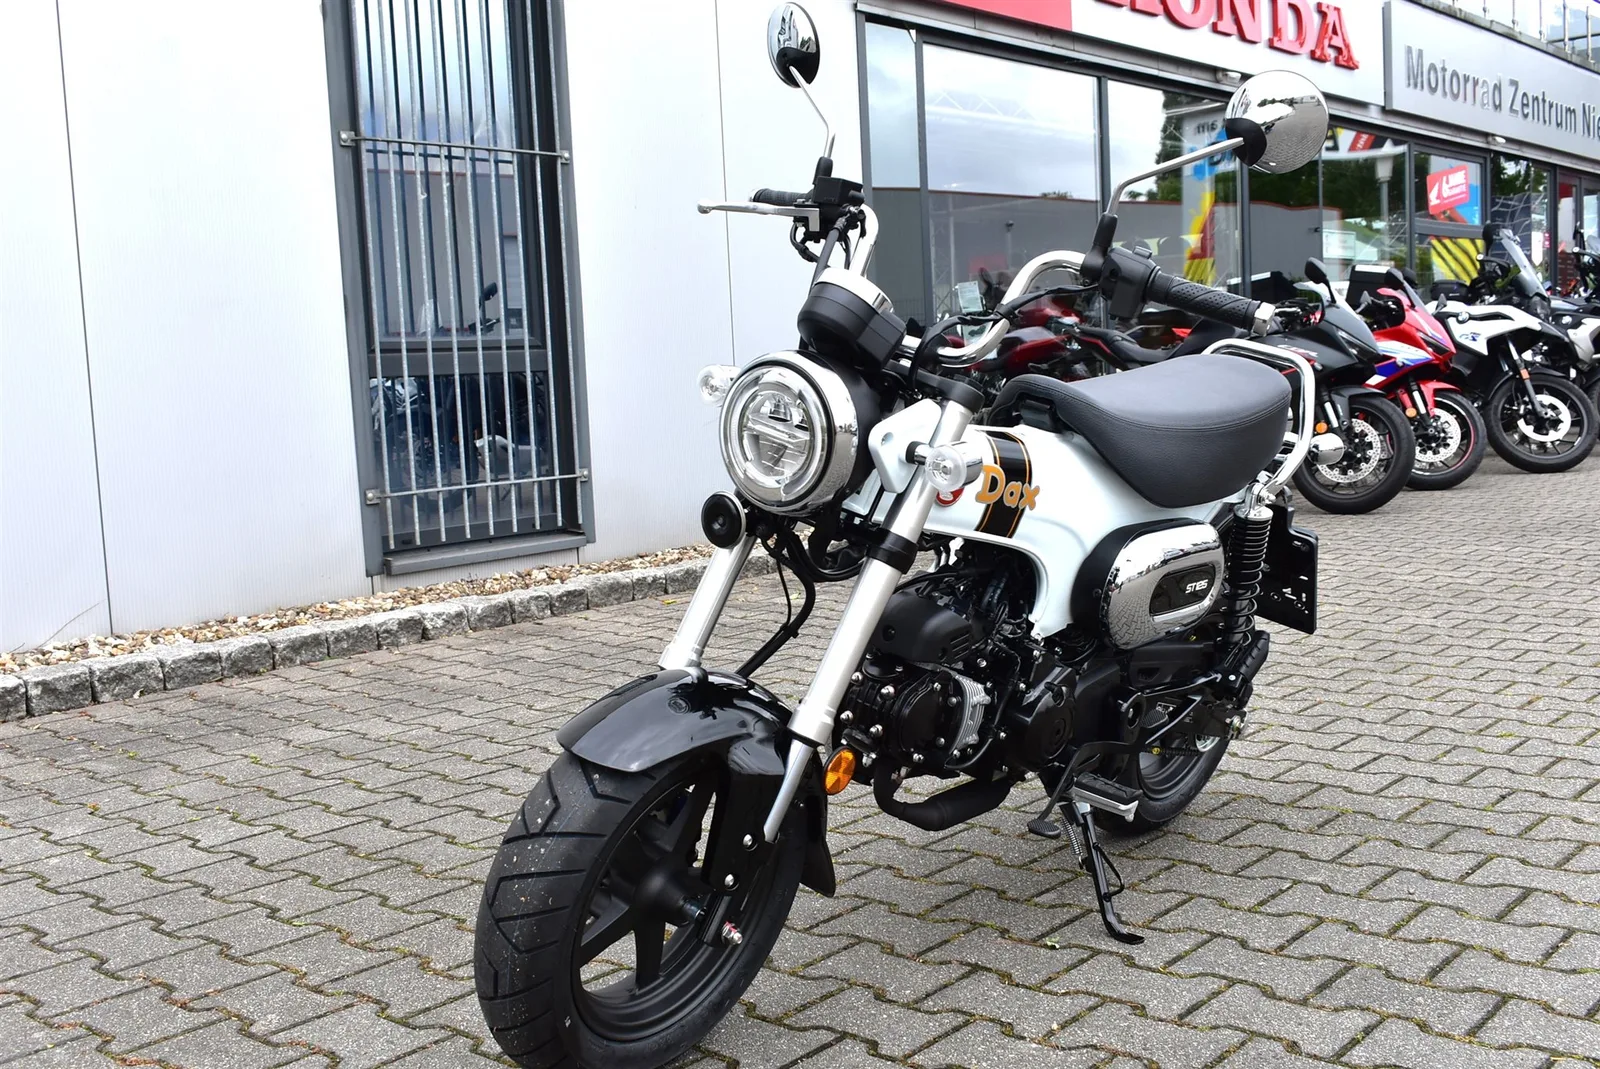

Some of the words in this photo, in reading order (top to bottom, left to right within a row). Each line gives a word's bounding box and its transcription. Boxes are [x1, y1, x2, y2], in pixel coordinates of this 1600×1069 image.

[1094, 0, 1359, 70] NDA
[1404, 44, 1502, 112] Motorrad
[1508, 78, 1577, 134] Zentrum
[974, 463, 1040, 511] Dax
